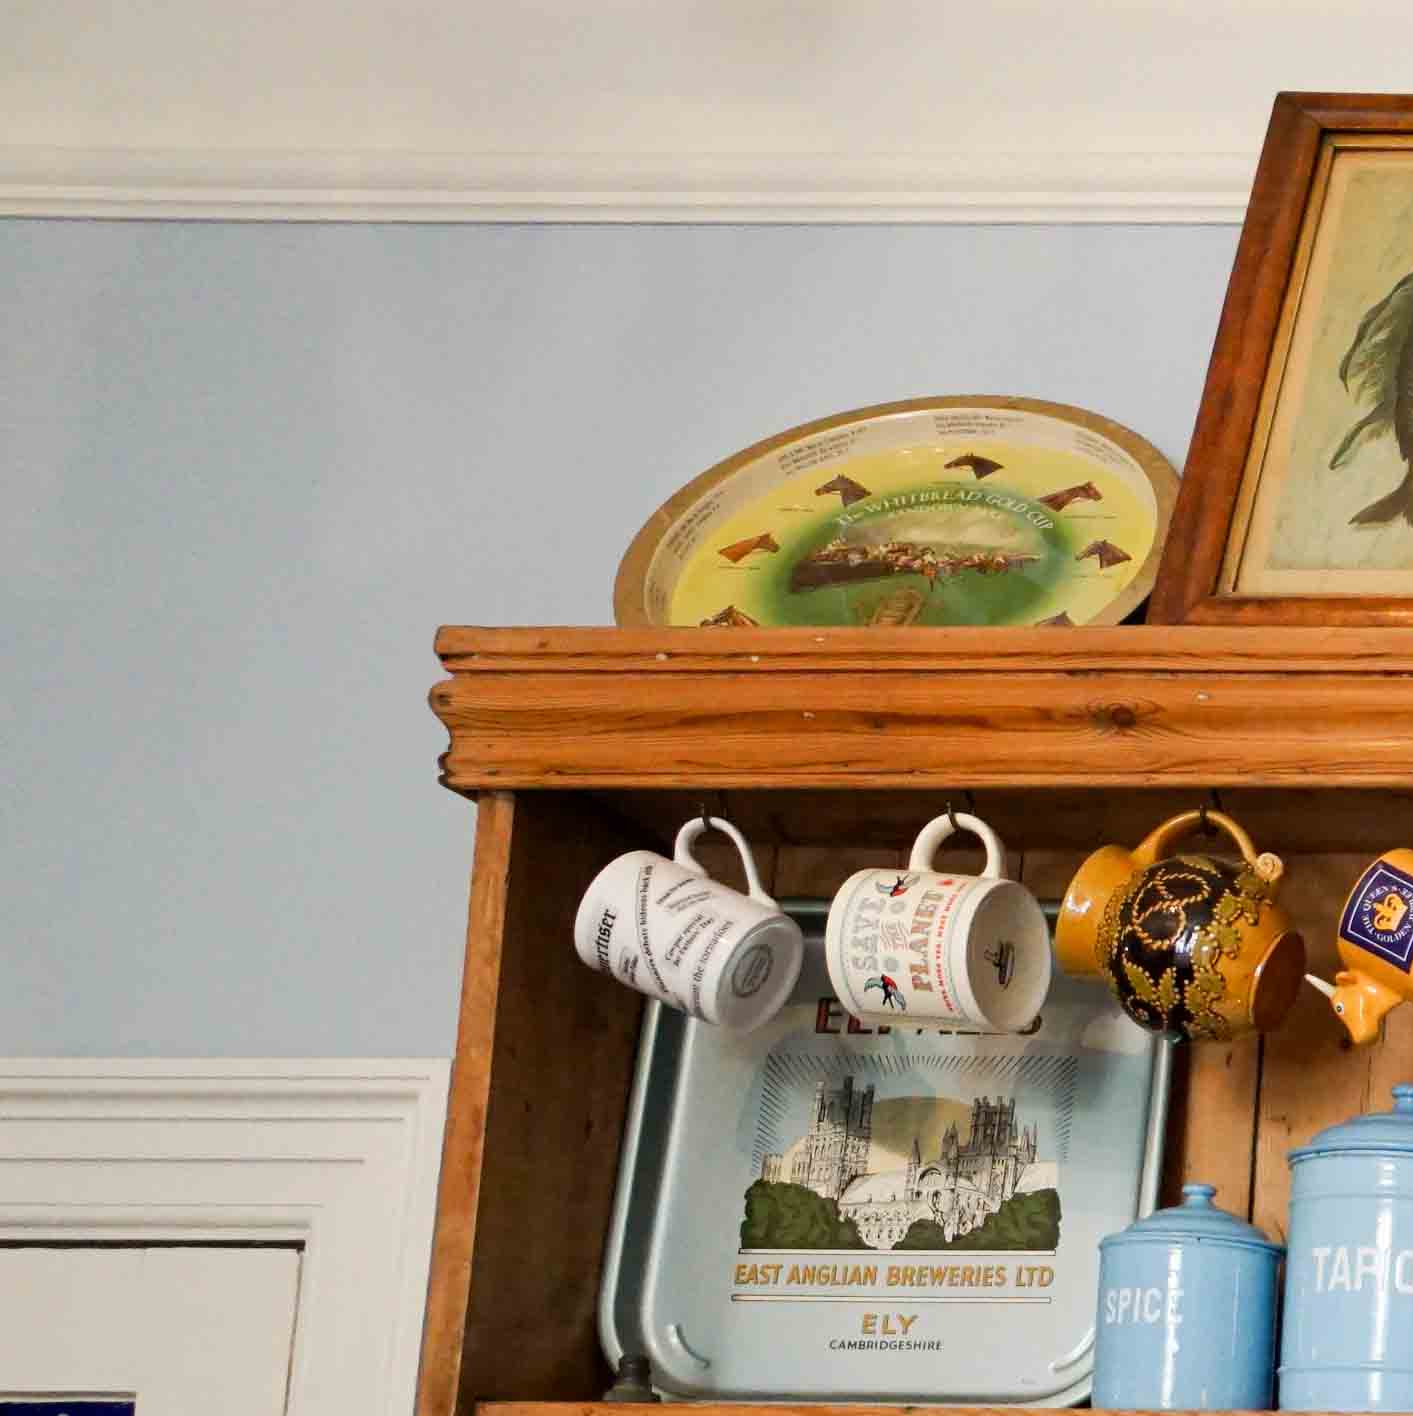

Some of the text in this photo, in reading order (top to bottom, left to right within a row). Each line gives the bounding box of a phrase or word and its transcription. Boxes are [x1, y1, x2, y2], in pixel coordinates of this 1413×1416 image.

[985, 494, 1027, 514] GOLD
[734, 1263, 1055, 1288] EAST ANGLIAN BREWERIES LTD
[1105, 1286, 1185, 1327] SPICE
[860, 1311, 919, 1336] ELY
[828, 1339, 944, 1352] CAMBRIDGESHIRE
